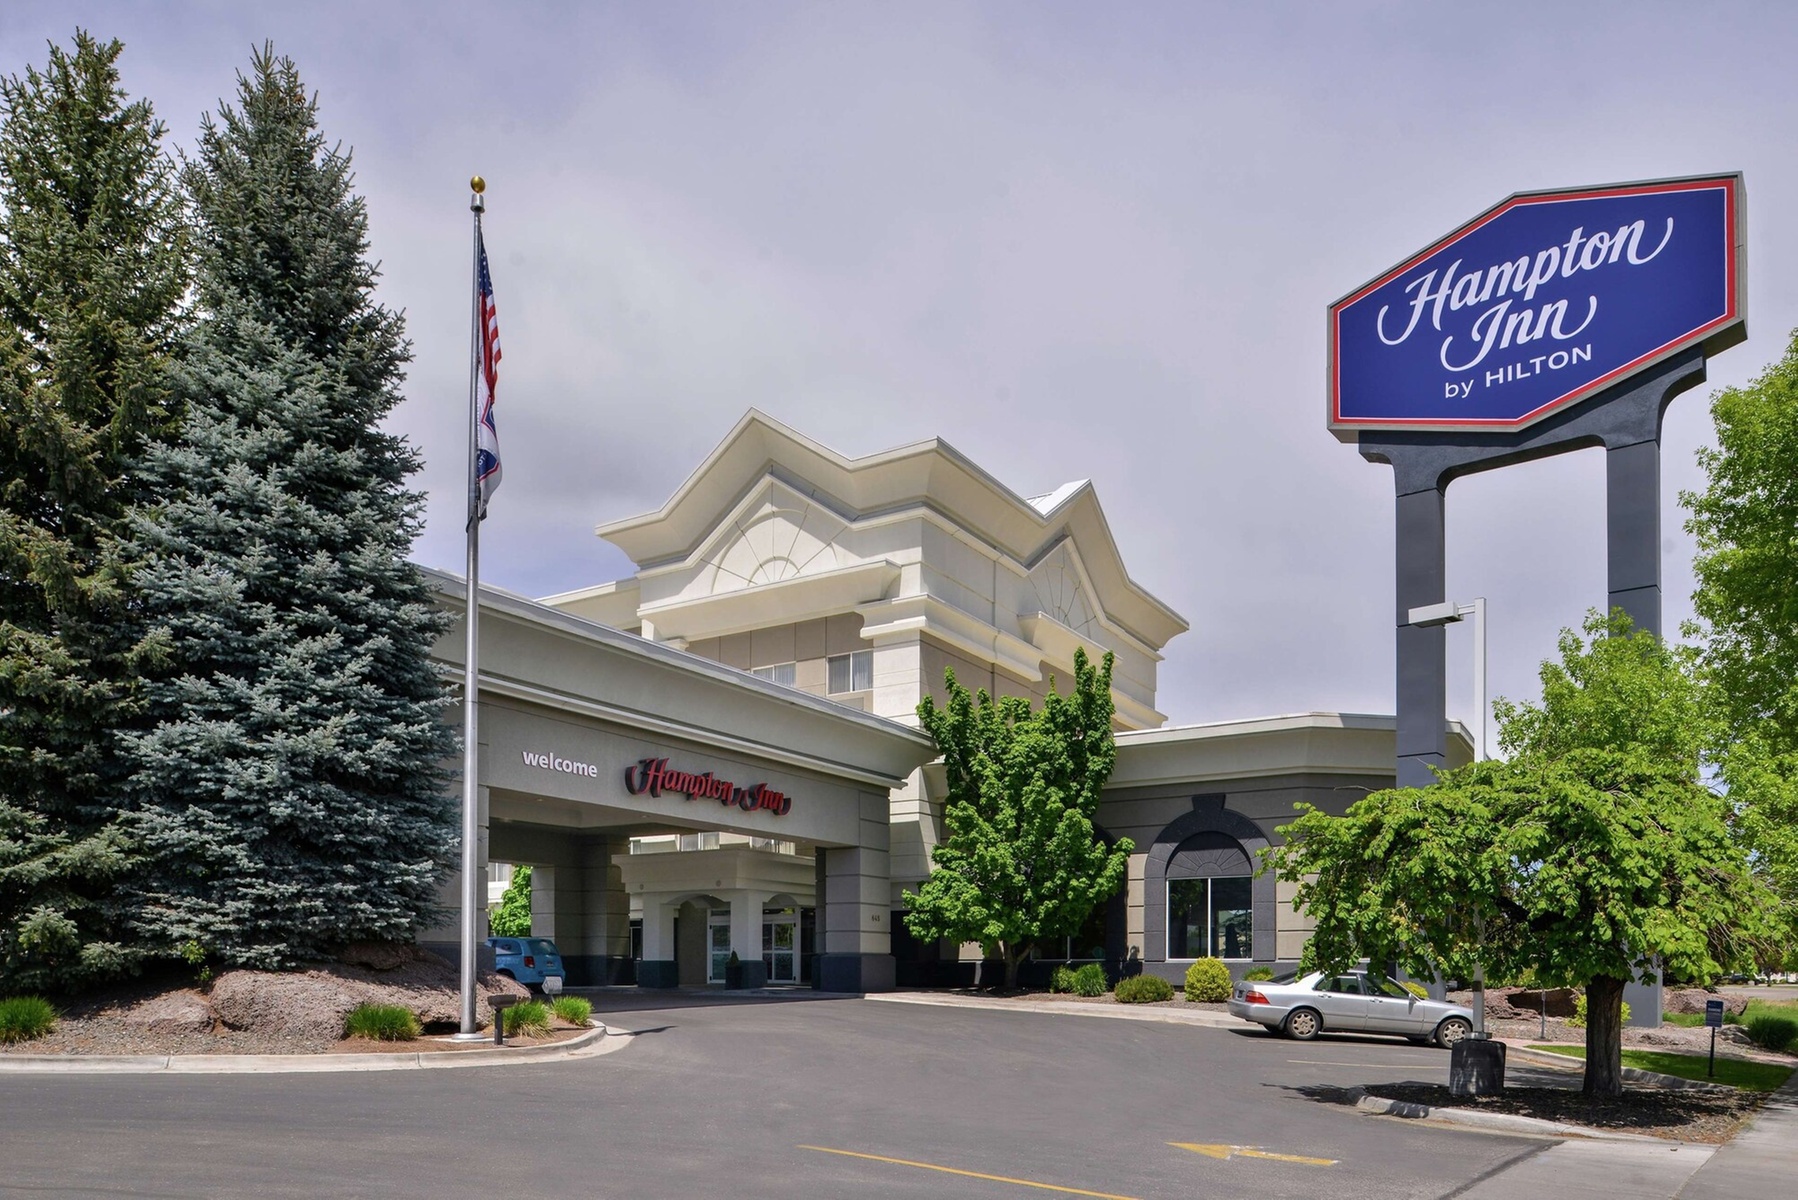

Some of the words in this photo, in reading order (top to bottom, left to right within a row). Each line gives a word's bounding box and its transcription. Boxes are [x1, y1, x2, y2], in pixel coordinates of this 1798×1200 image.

[1377, 217, 1673, 346] Hampton
[1440, 295, 1597, 372] Inn
[1445, 379, 1474, 399] by
[1485, 344, 1592, 388] HILTON
[522, 751, 598, 778] welcome
[624, 756, 742, 807] Hampton
[740, 783, 792, 816] Inn
